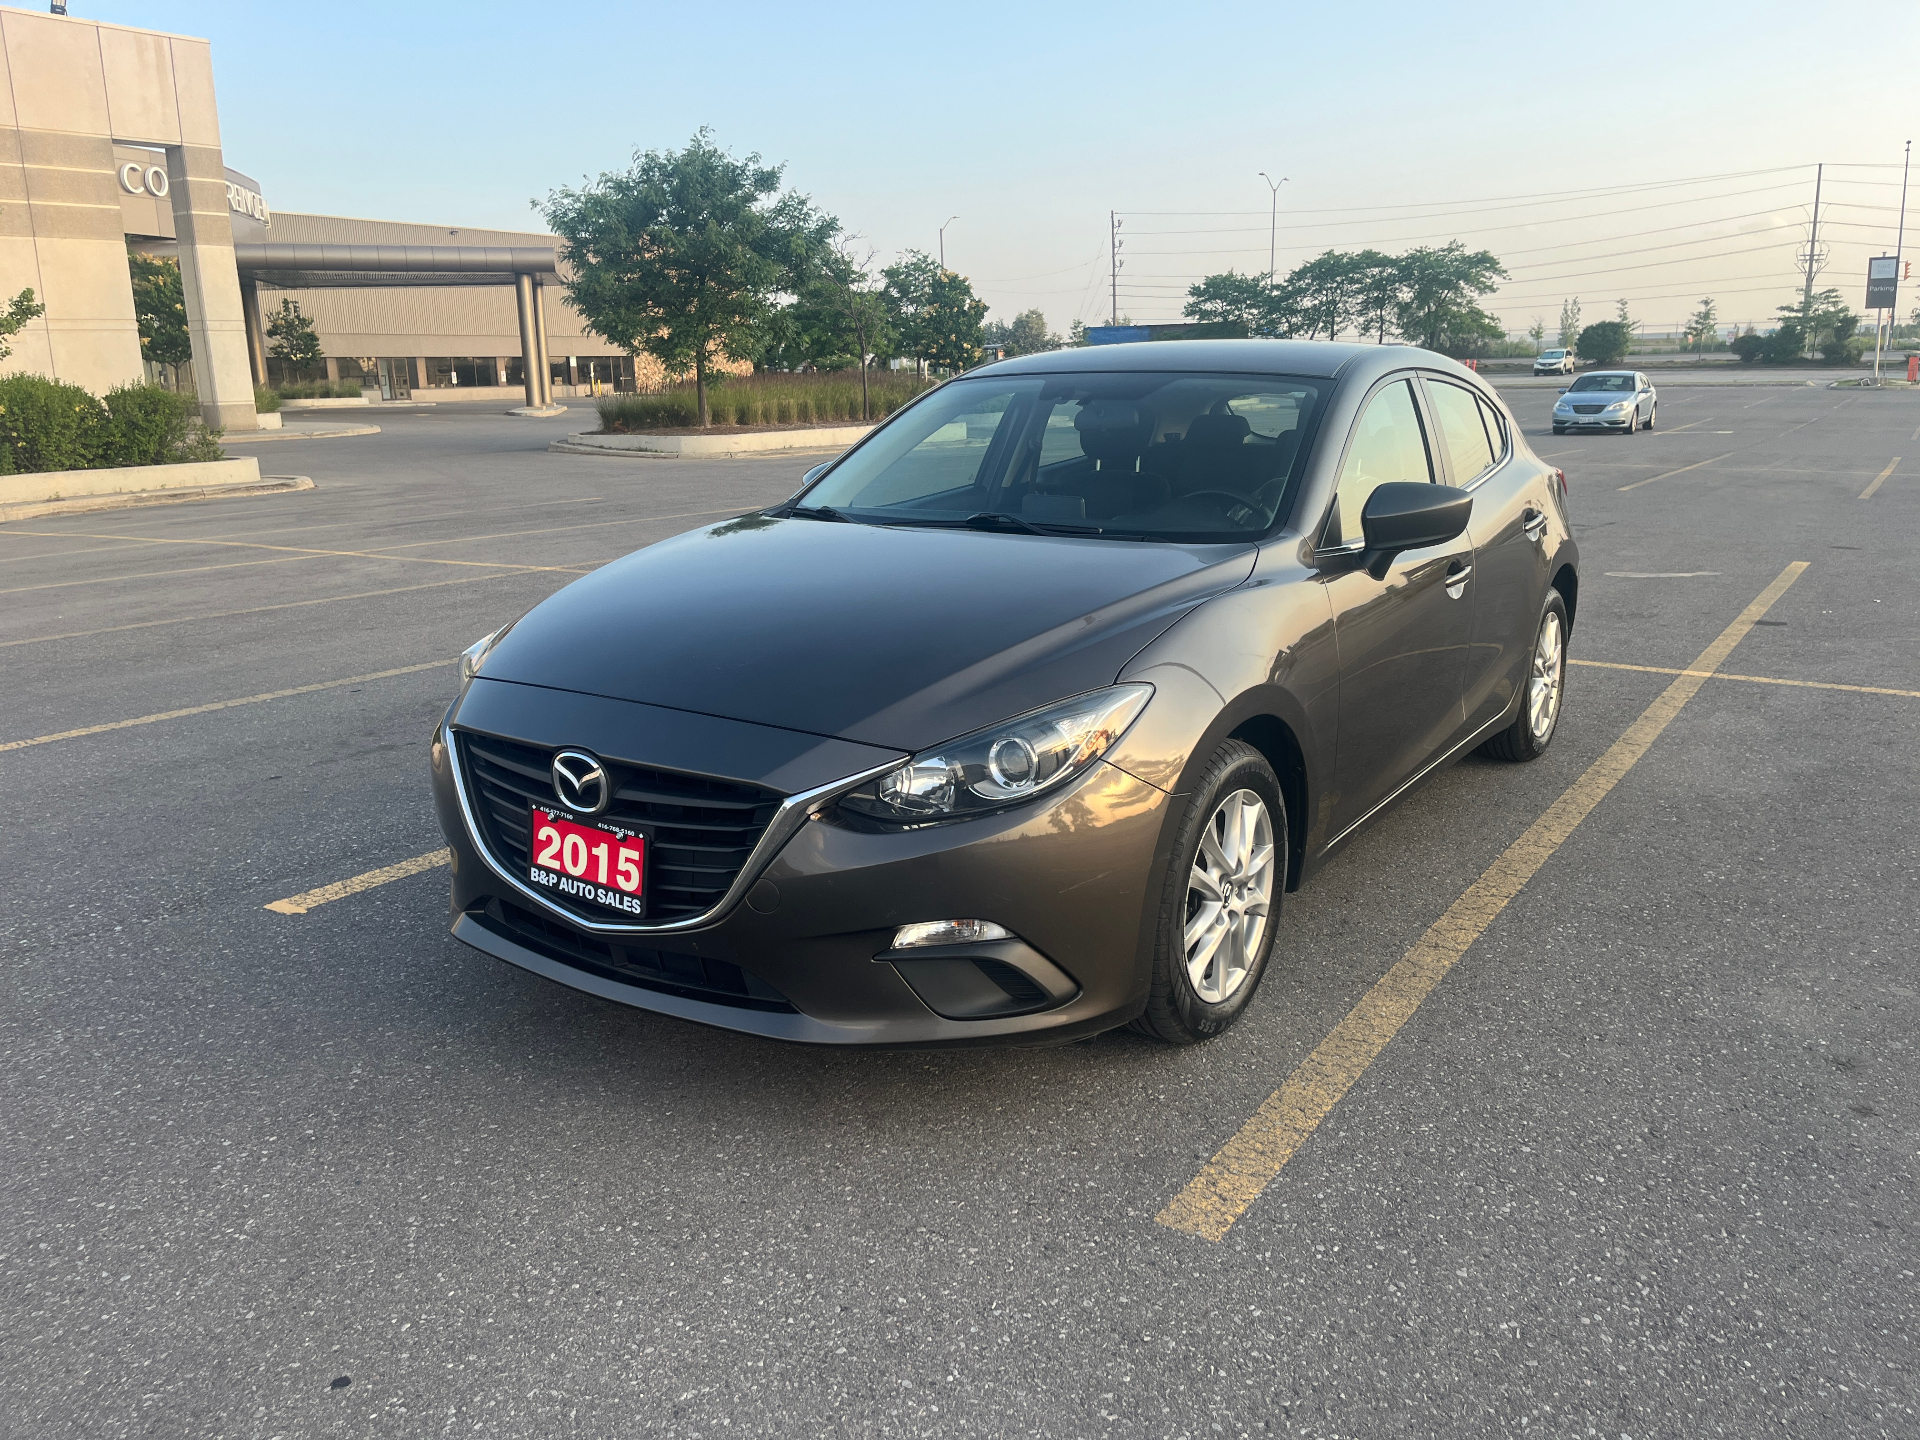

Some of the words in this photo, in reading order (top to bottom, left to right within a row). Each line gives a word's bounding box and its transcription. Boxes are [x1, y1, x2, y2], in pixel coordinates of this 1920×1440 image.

[537, 826, 640, 892] 2015
[530, 867, 558, 887] B&P
[559, 877, 595, 900] AUTO
[596, 888, 641, 914] SALES
